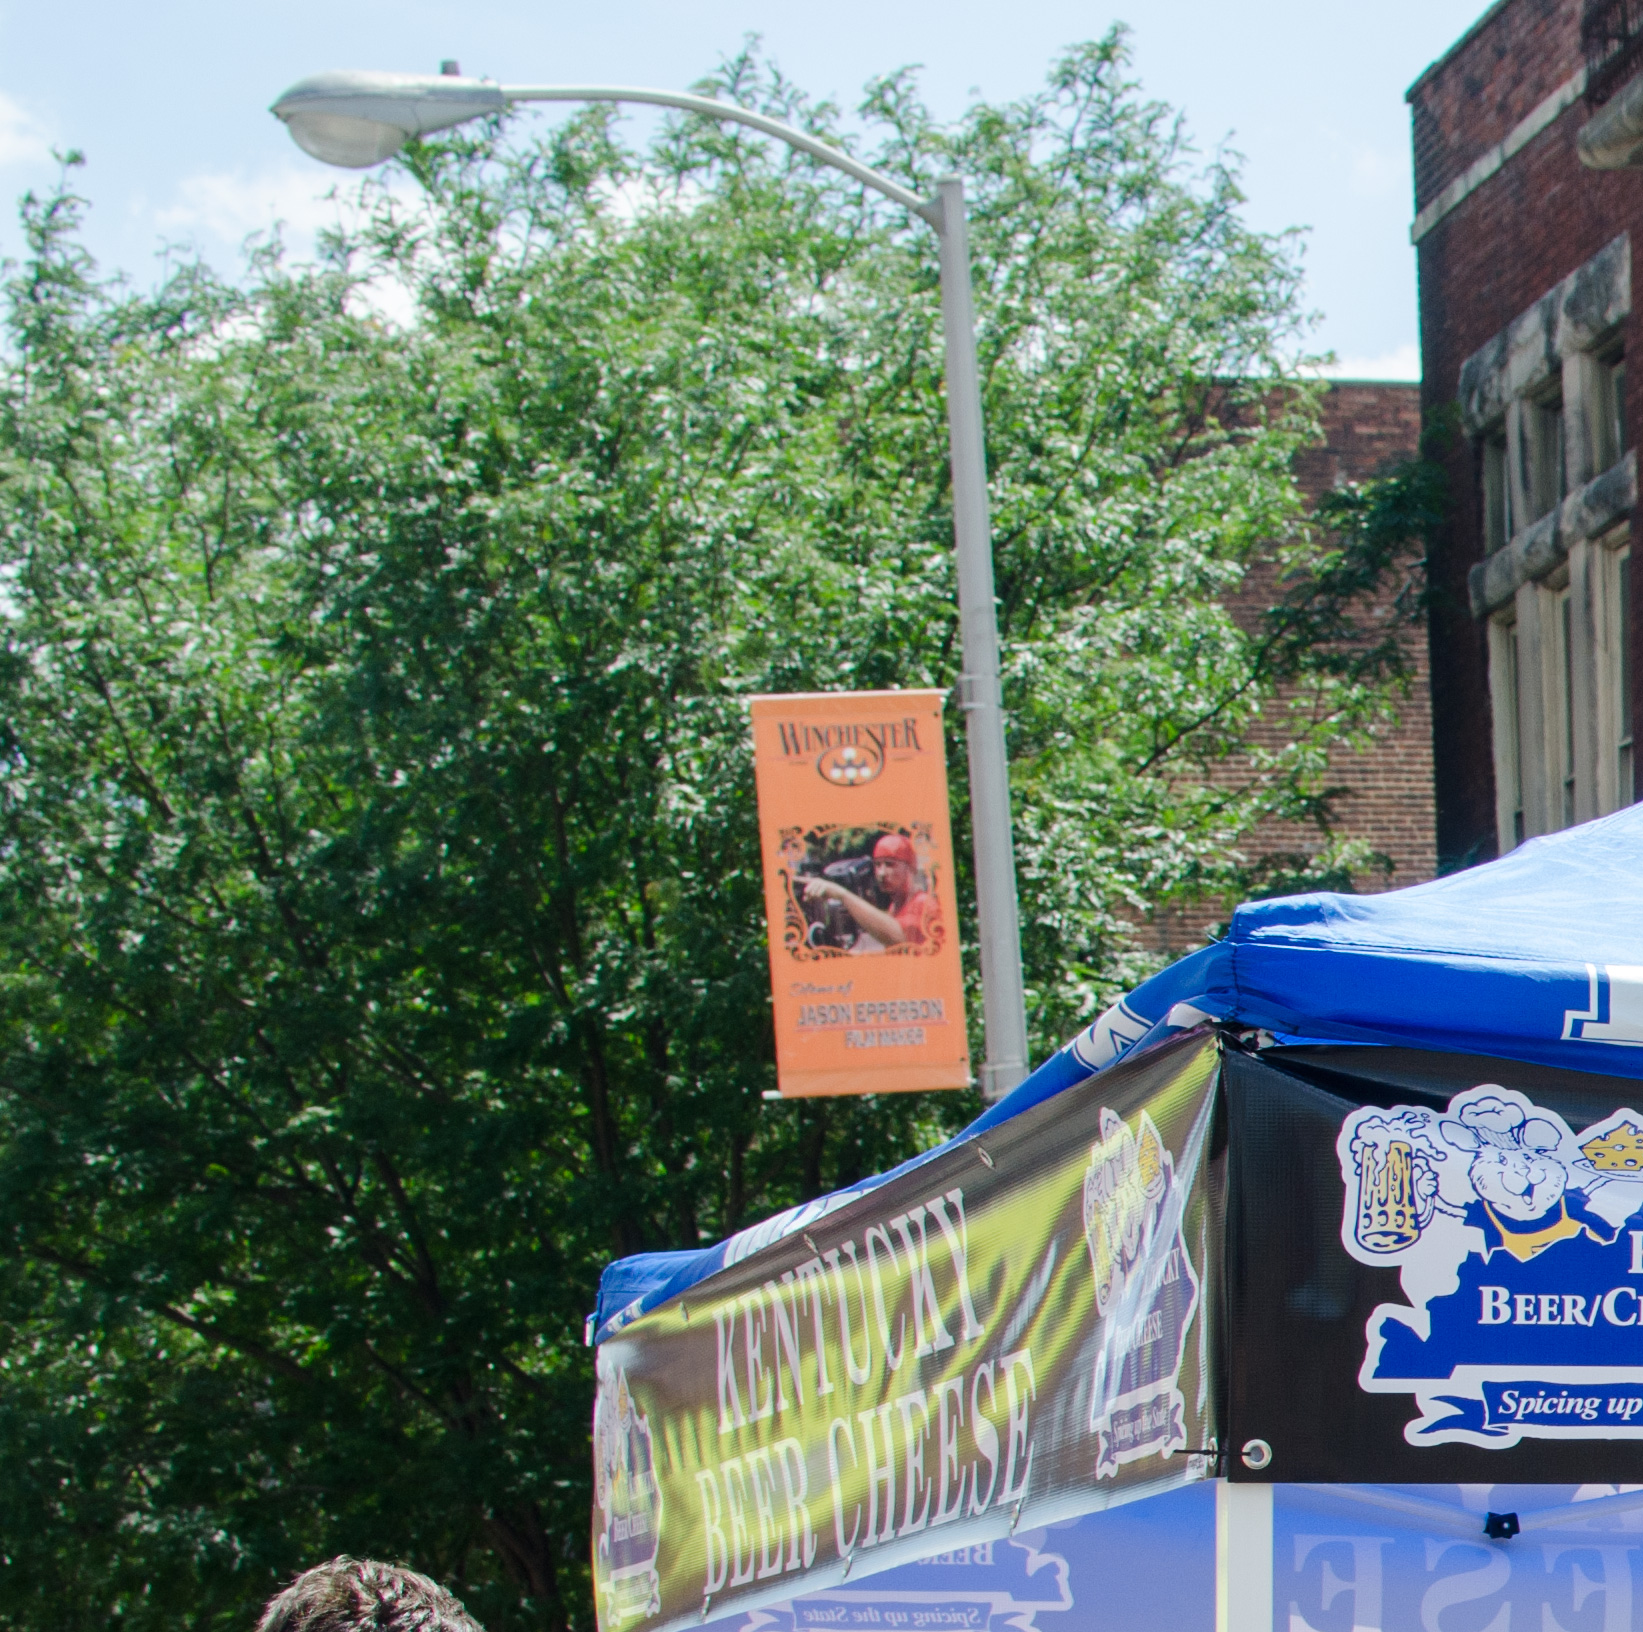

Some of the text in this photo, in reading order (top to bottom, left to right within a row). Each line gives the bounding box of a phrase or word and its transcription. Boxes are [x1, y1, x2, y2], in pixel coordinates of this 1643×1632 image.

[778, 717, 922, 757] WINCHESTER
[799, 999, 943, 1026] JASON EPPERSON
[845, 1028, 926, 1047] FILM MAKER
[713, 1188, 985, 1435] KENTUCKY
[1499, 1390, 1601, 1422] Spicing
[1607, 1396, 1642, 1422] up
[695, 1348, 1037, 1596] BEER CHEESE
